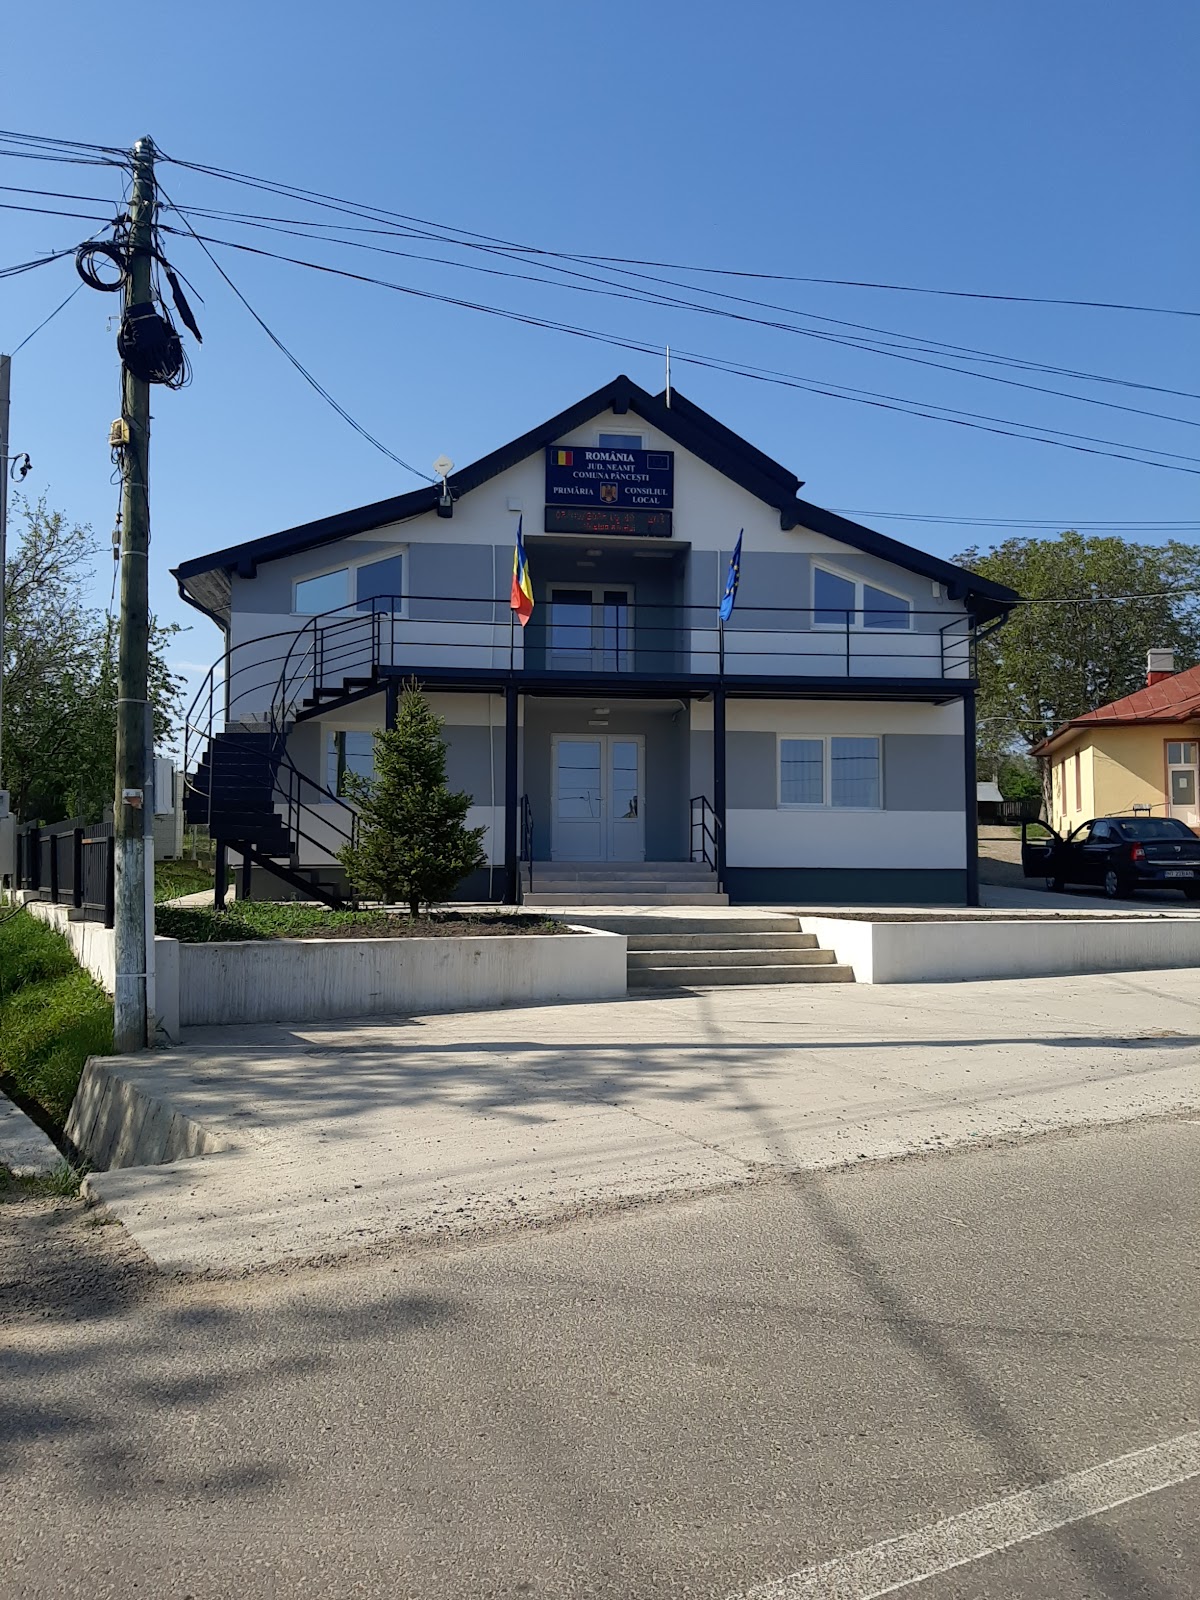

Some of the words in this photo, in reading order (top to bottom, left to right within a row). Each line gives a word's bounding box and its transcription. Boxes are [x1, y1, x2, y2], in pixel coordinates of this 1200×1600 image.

[585, 451, 635, 462] ROMÂNIA
[573, 471, 610, 480] COMUNA
[553, 486, 594, 495] PRIMĂRIA
[624, 487, 668, 496] CONSILIUL
[632, 496, 660, 504] LOCAL
